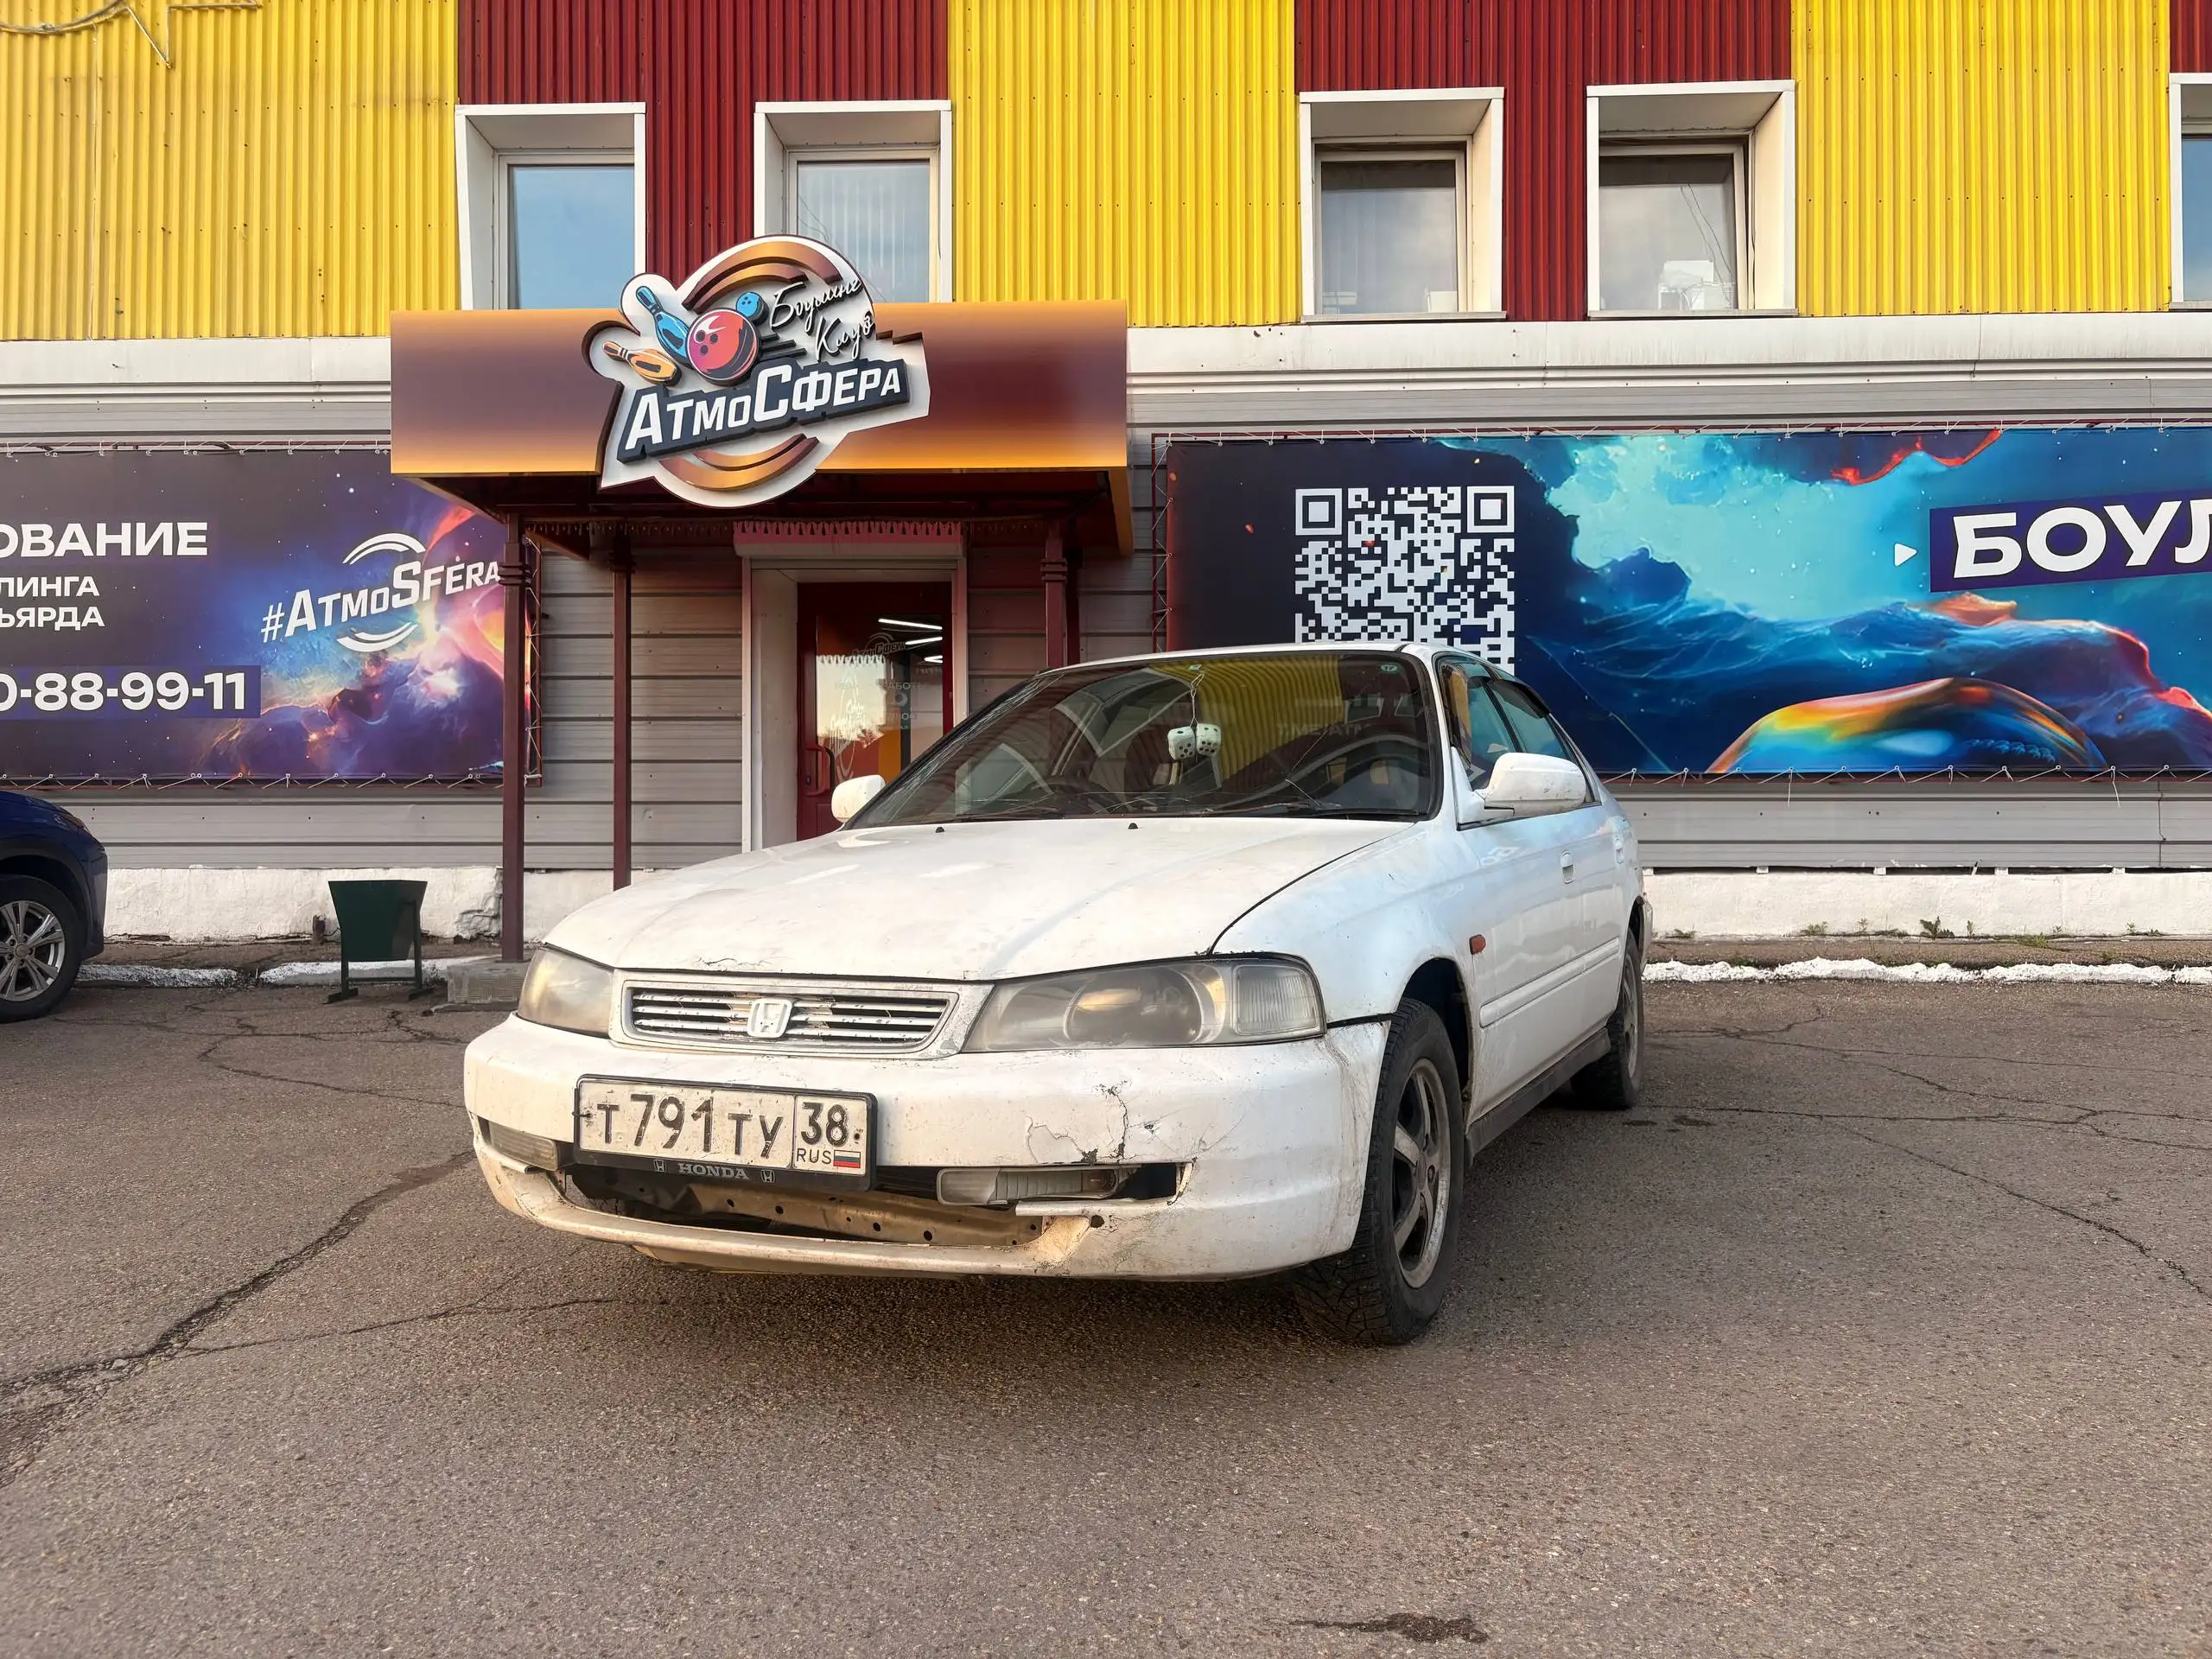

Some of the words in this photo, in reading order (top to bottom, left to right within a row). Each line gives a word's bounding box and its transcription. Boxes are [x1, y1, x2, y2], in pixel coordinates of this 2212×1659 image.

[1953, 499, 2212, 578] БОУЛ
[800, 1102, 849, 1147] 38
[677, 1162, 750, 1179] HONDA
[796, 1147, 832, 1165] RUS
